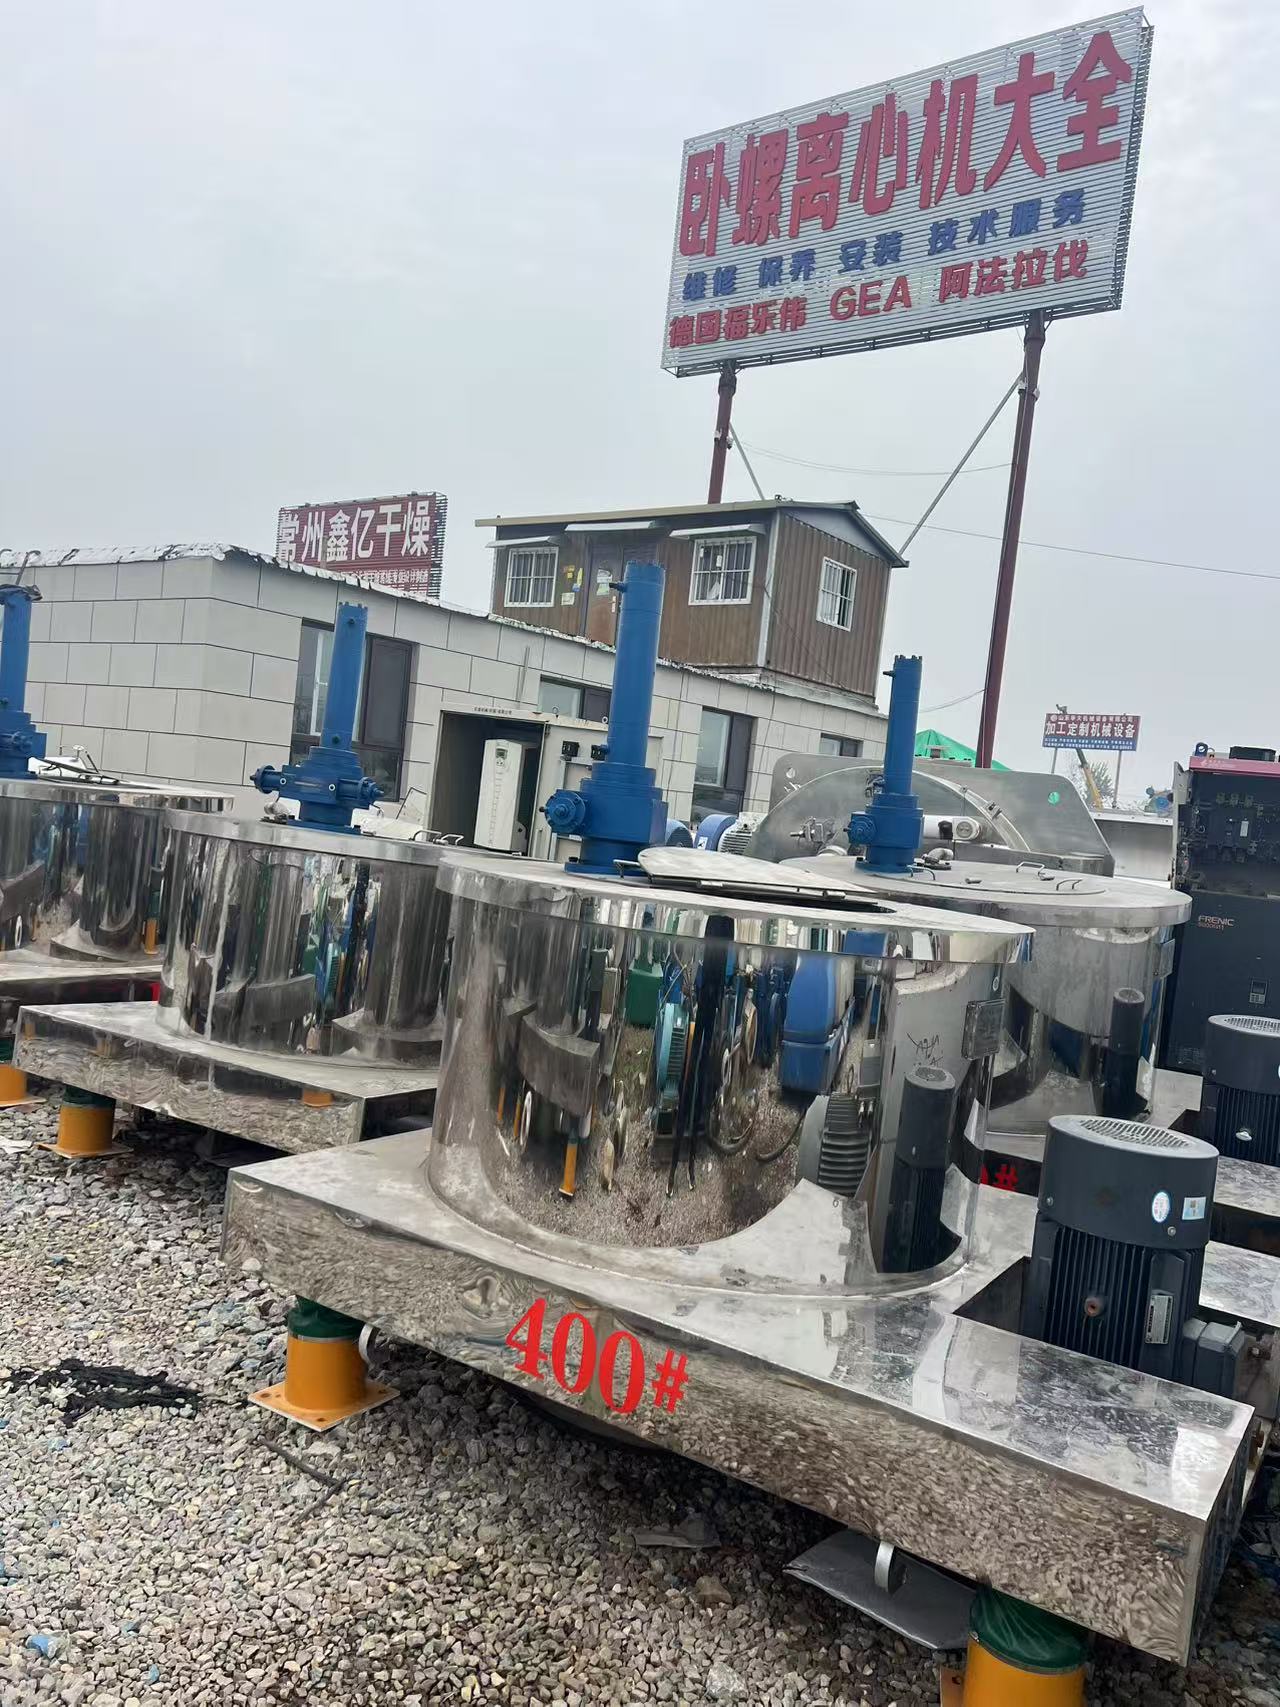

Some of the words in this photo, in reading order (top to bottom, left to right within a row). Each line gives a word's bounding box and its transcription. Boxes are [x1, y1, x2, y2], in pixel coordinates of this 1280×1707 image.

[679, 30, 1132, 256] 卧螺离心机大全
[669, 296, 807, 348] 德国福乐伟
[829, 275, 912, 321] GEA
[939, 239, 1088, 303] 阿法拉伐
[682, 264, 738, 301] 维修
[758, 248, 816, 288] 保养
[838, 231, 904, 274] 安装
[928, 188, 1085, 256] 技术服务
[276, 500, 431, 562] 常州鑫亿干燥
[1045, 721, 1136, 738] 加工定制机械设备
[1199, 915, 1235, 927] FRENIC
[505, 1297, 689, 1414] 400#
